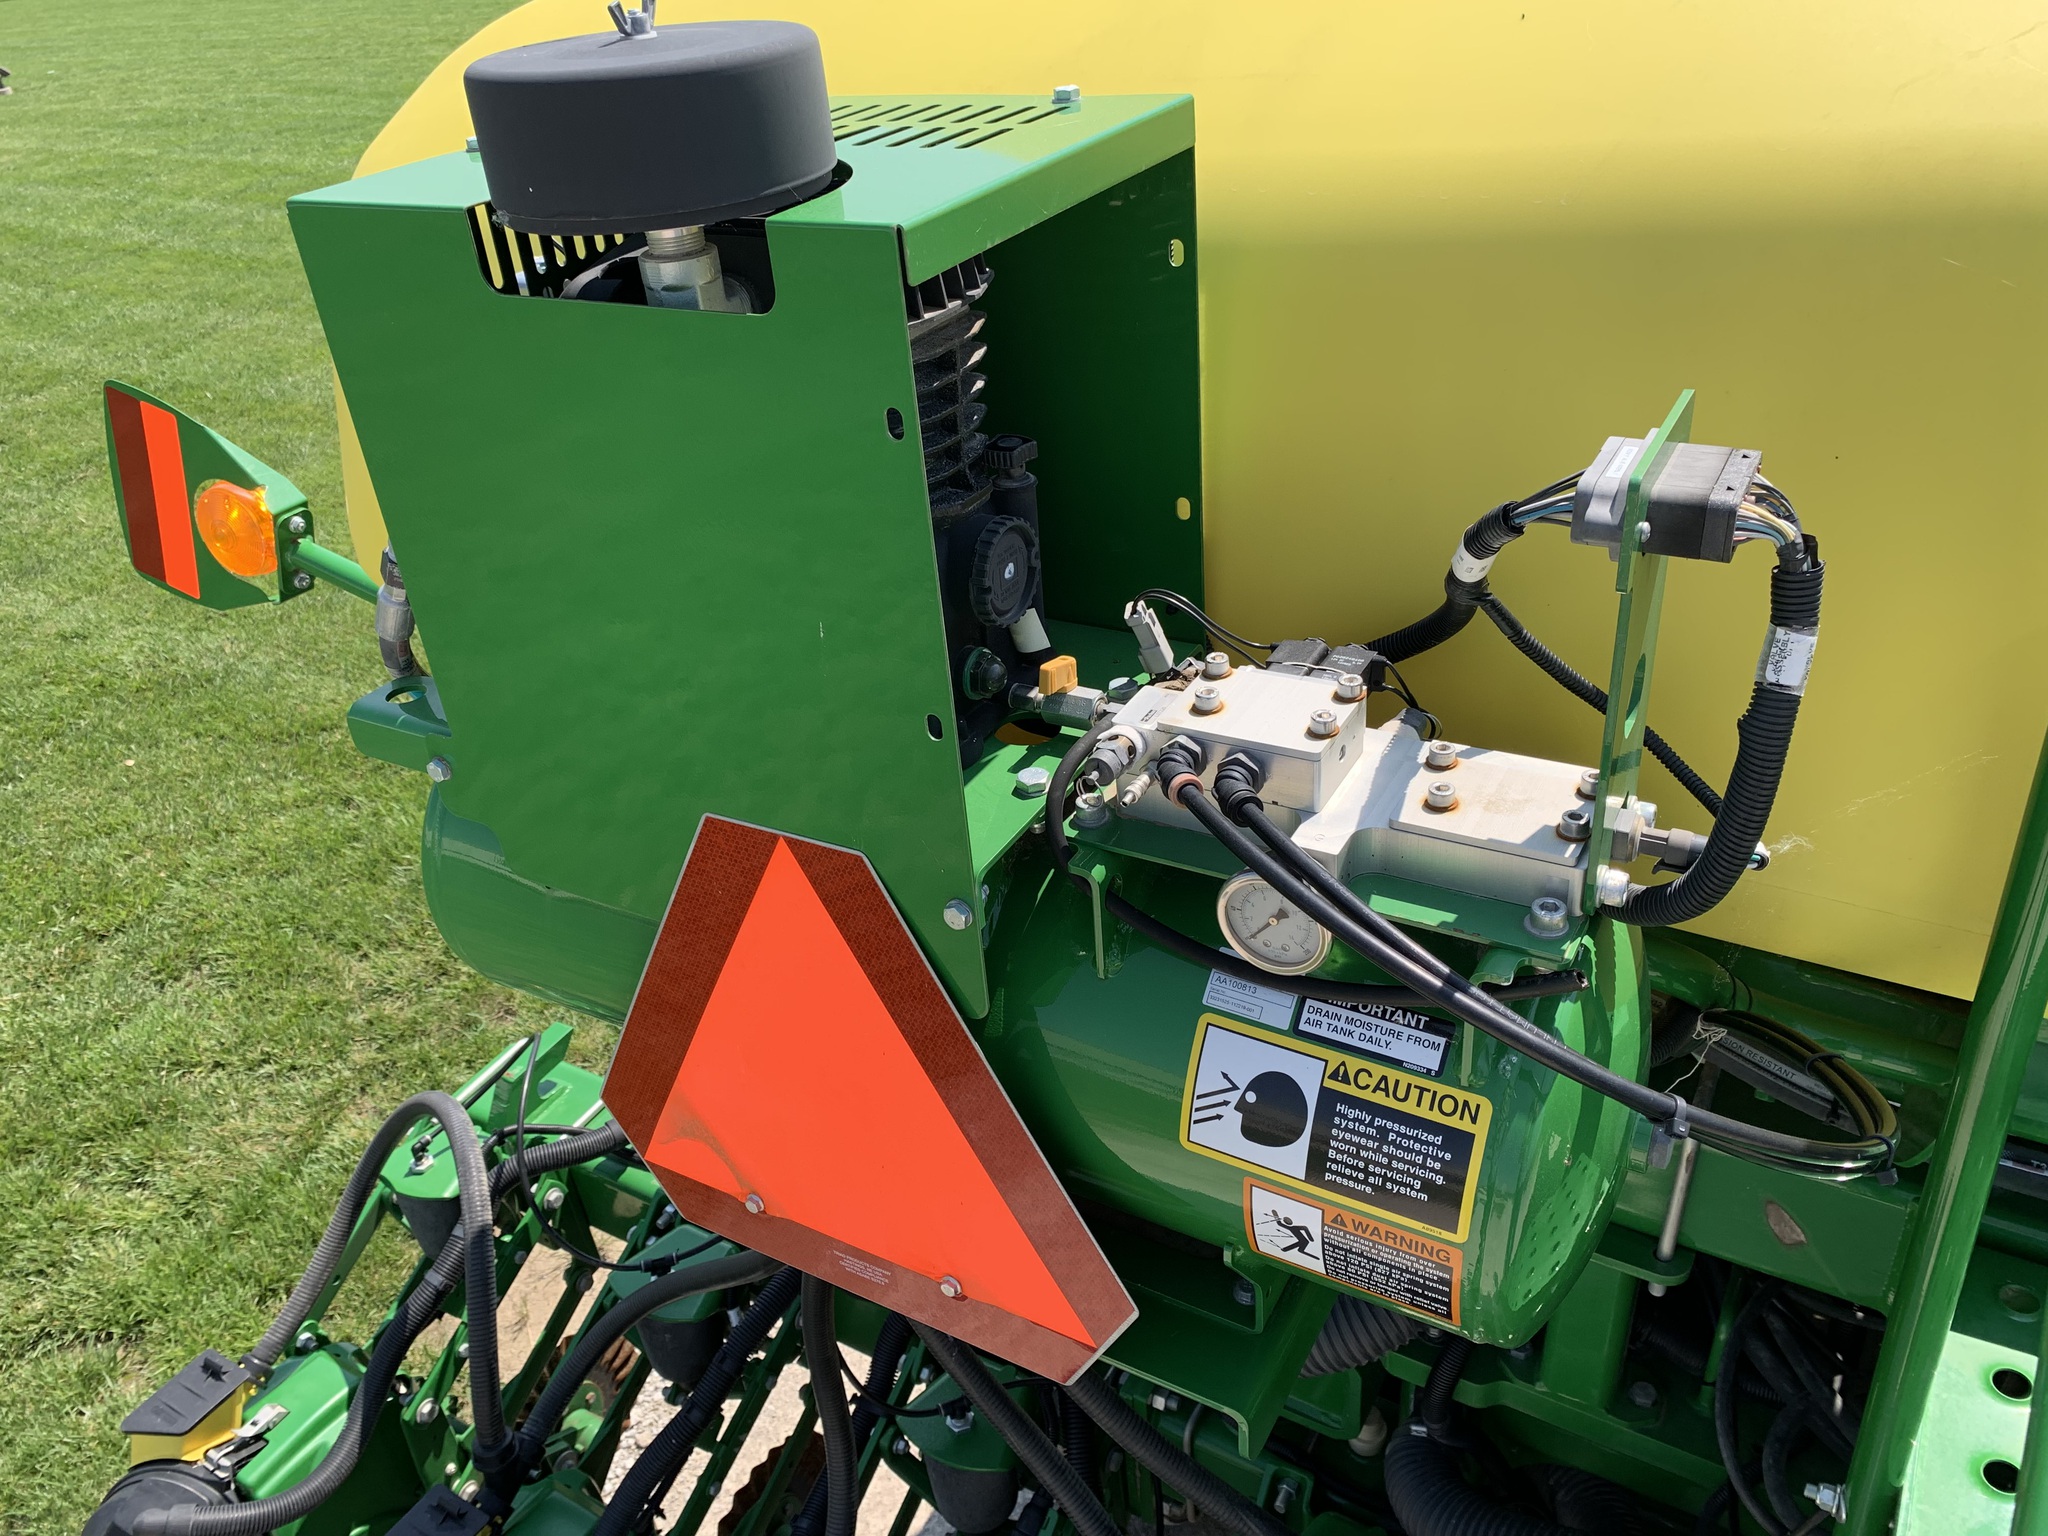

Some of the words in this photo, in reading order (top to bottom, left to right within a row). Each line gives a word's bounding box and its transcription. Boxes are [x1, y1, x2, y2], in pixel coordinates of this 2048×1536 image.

[1214, 975, 1258, 995] AA100813
[1303, 1017, 1324, 1032] AIR
[1325, 1023, 1356, 1040] TANK
[1357, 1031, 1393, 1051] DAILY.
[1306, 1004, 1343, 1022] DRAIN
[1343, 1013, 1404, 1041] MOISTURE
[1405, 1033, 1442, 1052] FROM
[1745, 1048, 1797, 1081] RESISTANT
[1353, 1067, 1481, 1126] CAUTION
[1333, 1115, 1380, 1138] system.
[1388, 1132, 1452, 1161] Protective
[1335, 1102, 1373, 1124] Highly
[1374, 1116, 1443, 1146] pressurized
[1328, 1149, 1365, 1169] Before
[1367, 1162, 1422, 1190] servicing
[1329, 1139, 1357, 1155] worn
[1359, 1149, 1389, 1165] while
[1391, 1159, 1447, 1185] servicing.
[1331, 1127, 1380, 1150] eyewear
[1382, 1144, 1423, 1165] should
[1426, 1157, 1442, 1170] be
[1325, 1172, 1375, 1196] pressure.
[1326, 1161, 1365, 1180] relieve
[1367, 1174, 1383, 1186] all
[1385, 1181, 1428, 1202] system
[1323, 1232, 1369, 1252] pressurization
[1379, 1251, 1411, 1266] operating
[1425, 1267, 1449, 1280] system
[1324, 1225, 1343, 1236] Avoid
[1345, 1233, 1373, 1247] serious
[1375, 1243, 1396, 1256] injury
[1399, 1251, 1416, 1262] from
[1419, 1258, 1435, 1268] over
[1324, 1250, 1344, 1260] above
[1324, 1238, 1350, 1250] without
[1363, 1251, 1406, 1270] components
[1417, 1270, 1441, 1282] place.
[1350, 1218, 1451, 1264] WARNING
[1325, 1260, 1345, 1270] above
[1346, 1252, 1368, 1263] inflate
[1369, 1260, 1389, 1271] single
[1402, 1272, 1424, 1283] spring
[1425, 1280, 1449, 1292] system
[1400, 1282, 1422, 1294] spring
[1424, 1290, 1449, 1303] system
